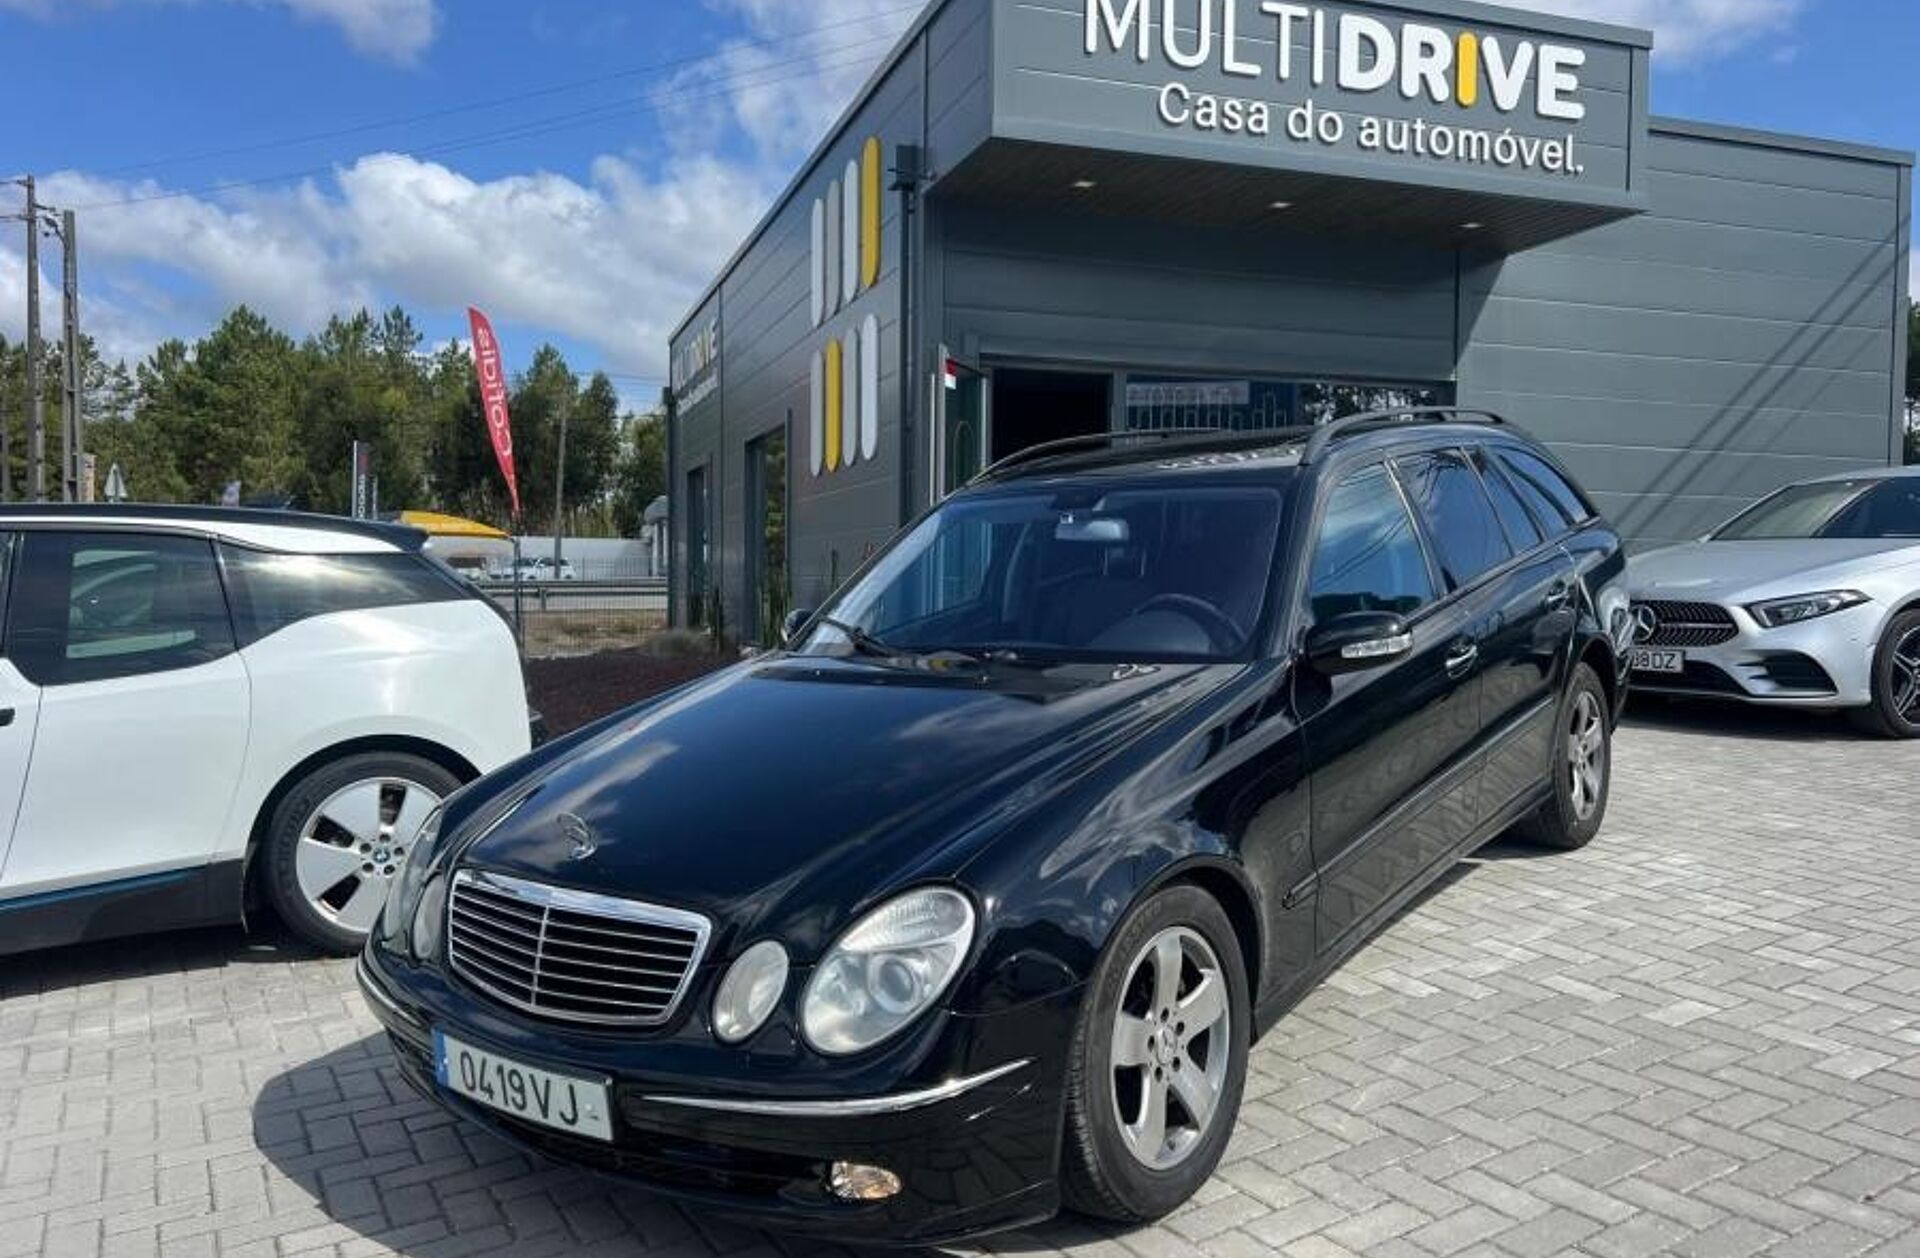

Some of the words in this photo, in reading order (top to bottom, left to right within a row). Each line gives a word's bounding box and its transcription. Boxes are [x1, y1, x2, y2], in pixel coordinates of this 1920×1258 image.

[1085, 0, 1586, 119] MULTIDRIVE
[1159, 83, 1269, 133] Casa
[1287, 101, 1344, 143] do
[1358, 118, 1585, 173] automóvel.
[460, 1050, 579, 1127] 0419VJ
